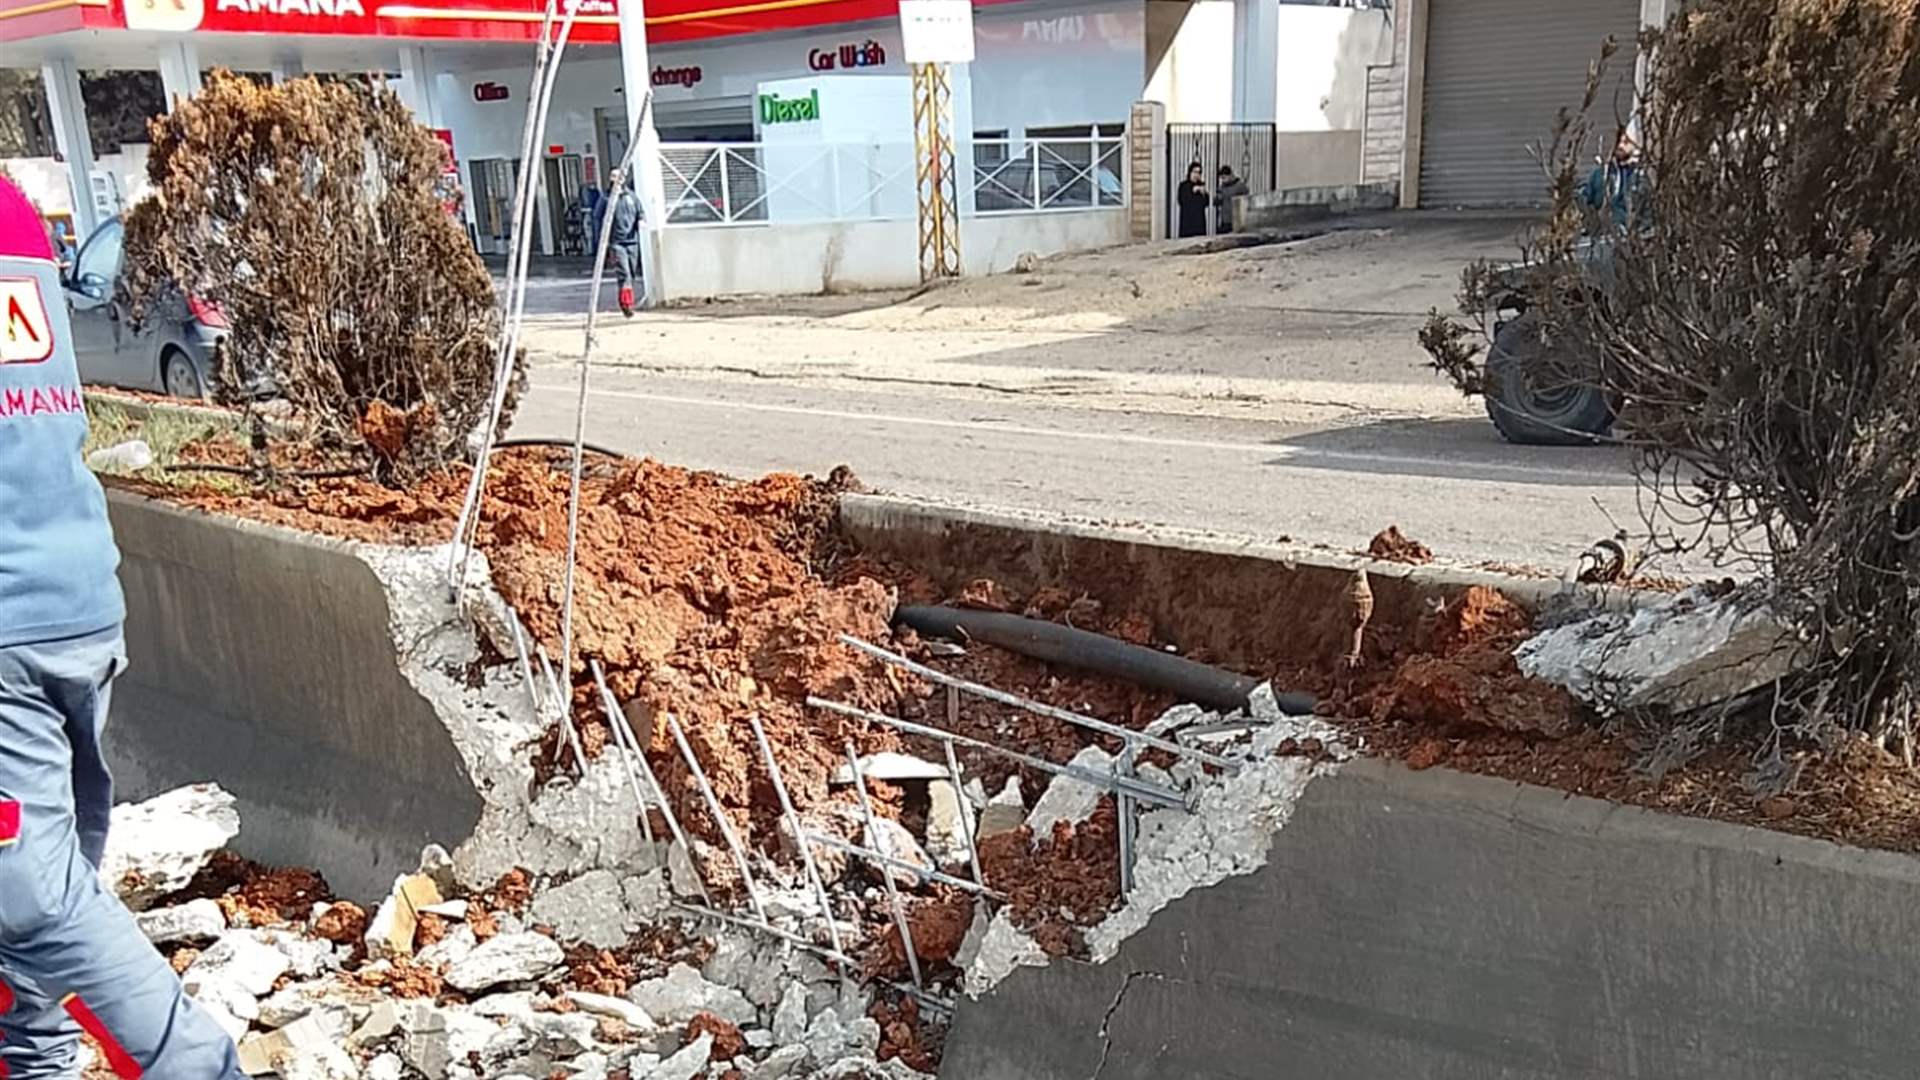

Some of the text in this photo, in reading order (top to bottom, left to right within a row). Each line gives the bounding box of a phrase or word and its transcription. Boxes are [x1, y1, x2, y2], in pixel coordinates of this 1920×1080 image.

[809, 41, 885, 71] Car Wash
[652, 65, 702, 88] change
[759, 88, 820, 125] Diesel
